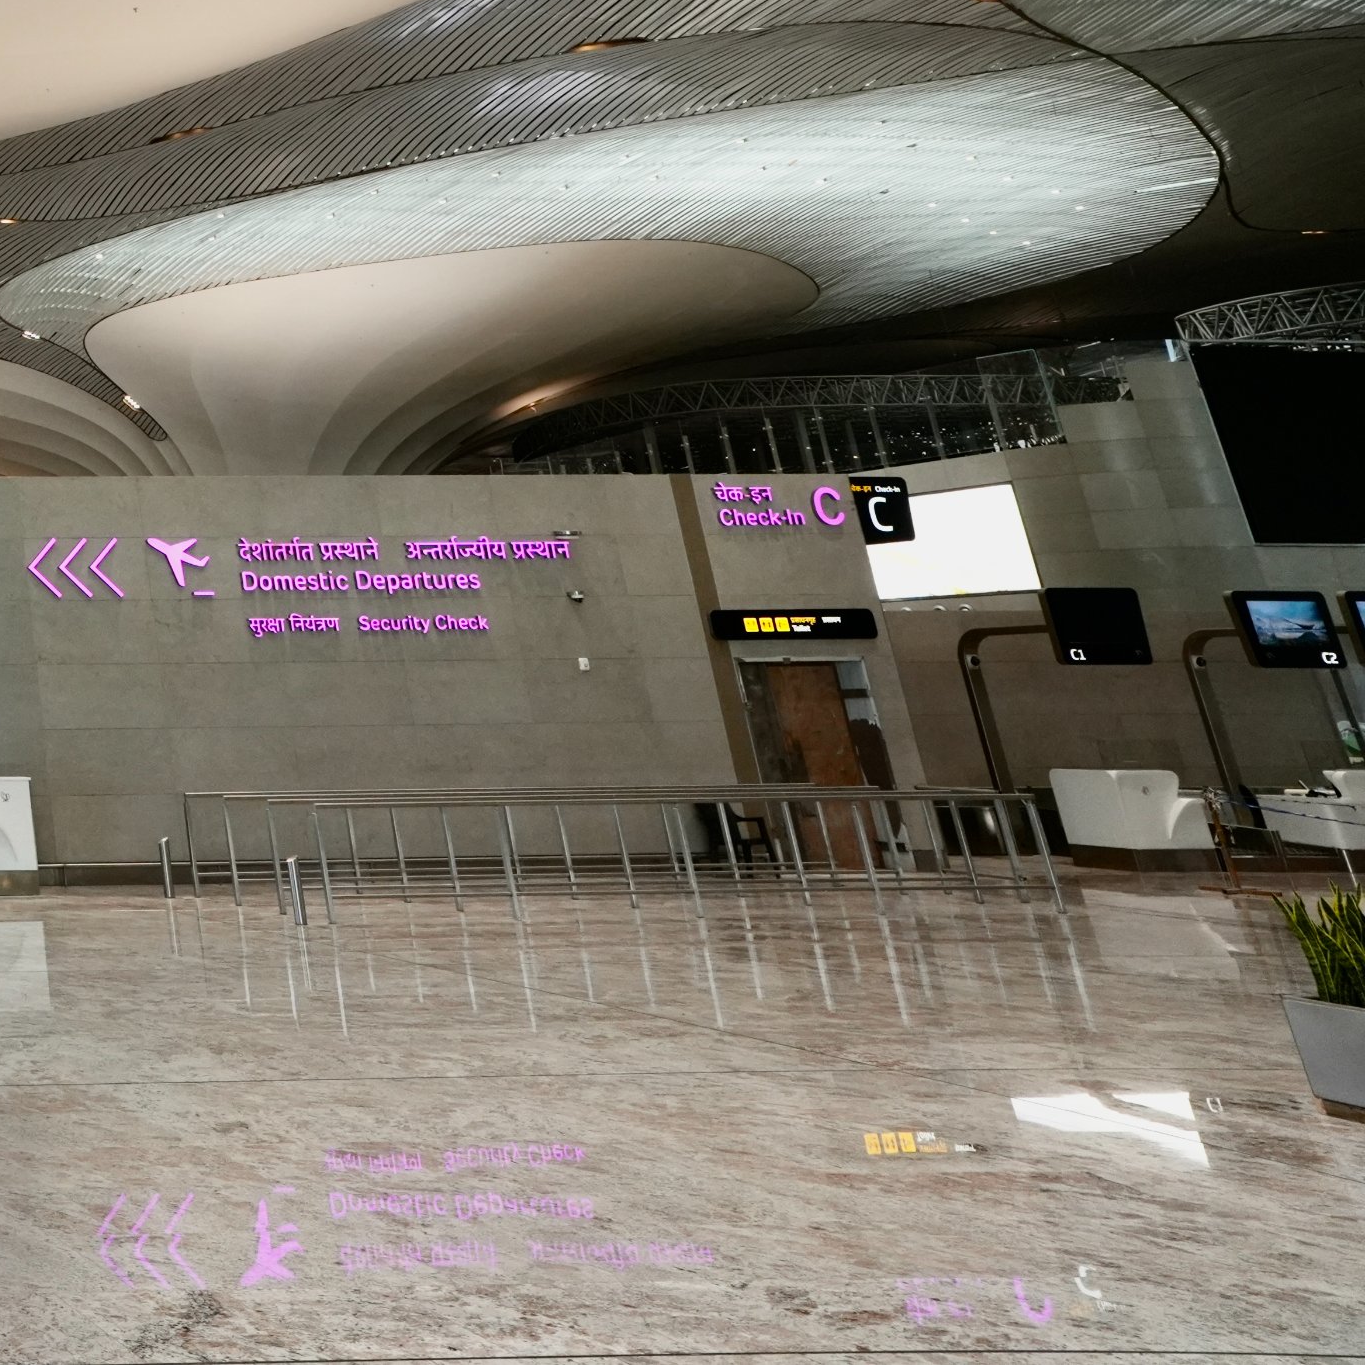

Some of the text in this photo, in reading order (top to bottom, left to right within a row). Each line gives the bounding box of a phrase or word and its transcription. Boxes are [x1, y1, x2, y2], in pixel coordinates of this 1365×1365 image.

[713, 482, 772, 504] चेक-इन
[719, 486, 845, 526] Check-In C
[868, 496, 893, 532] C
[237, 536, 570, 562] देशांतर्गत प्रस्थाने अन्तर्राज्यीय प्रस्थान
[241, 570, 481, 595] Domestic Departures
[249, 613, 489, 638] सुरक्षा नियंत्रण Security Check
[1070, 648, 1087, 660] C1
[1321, 652, 1339, 664] C2
